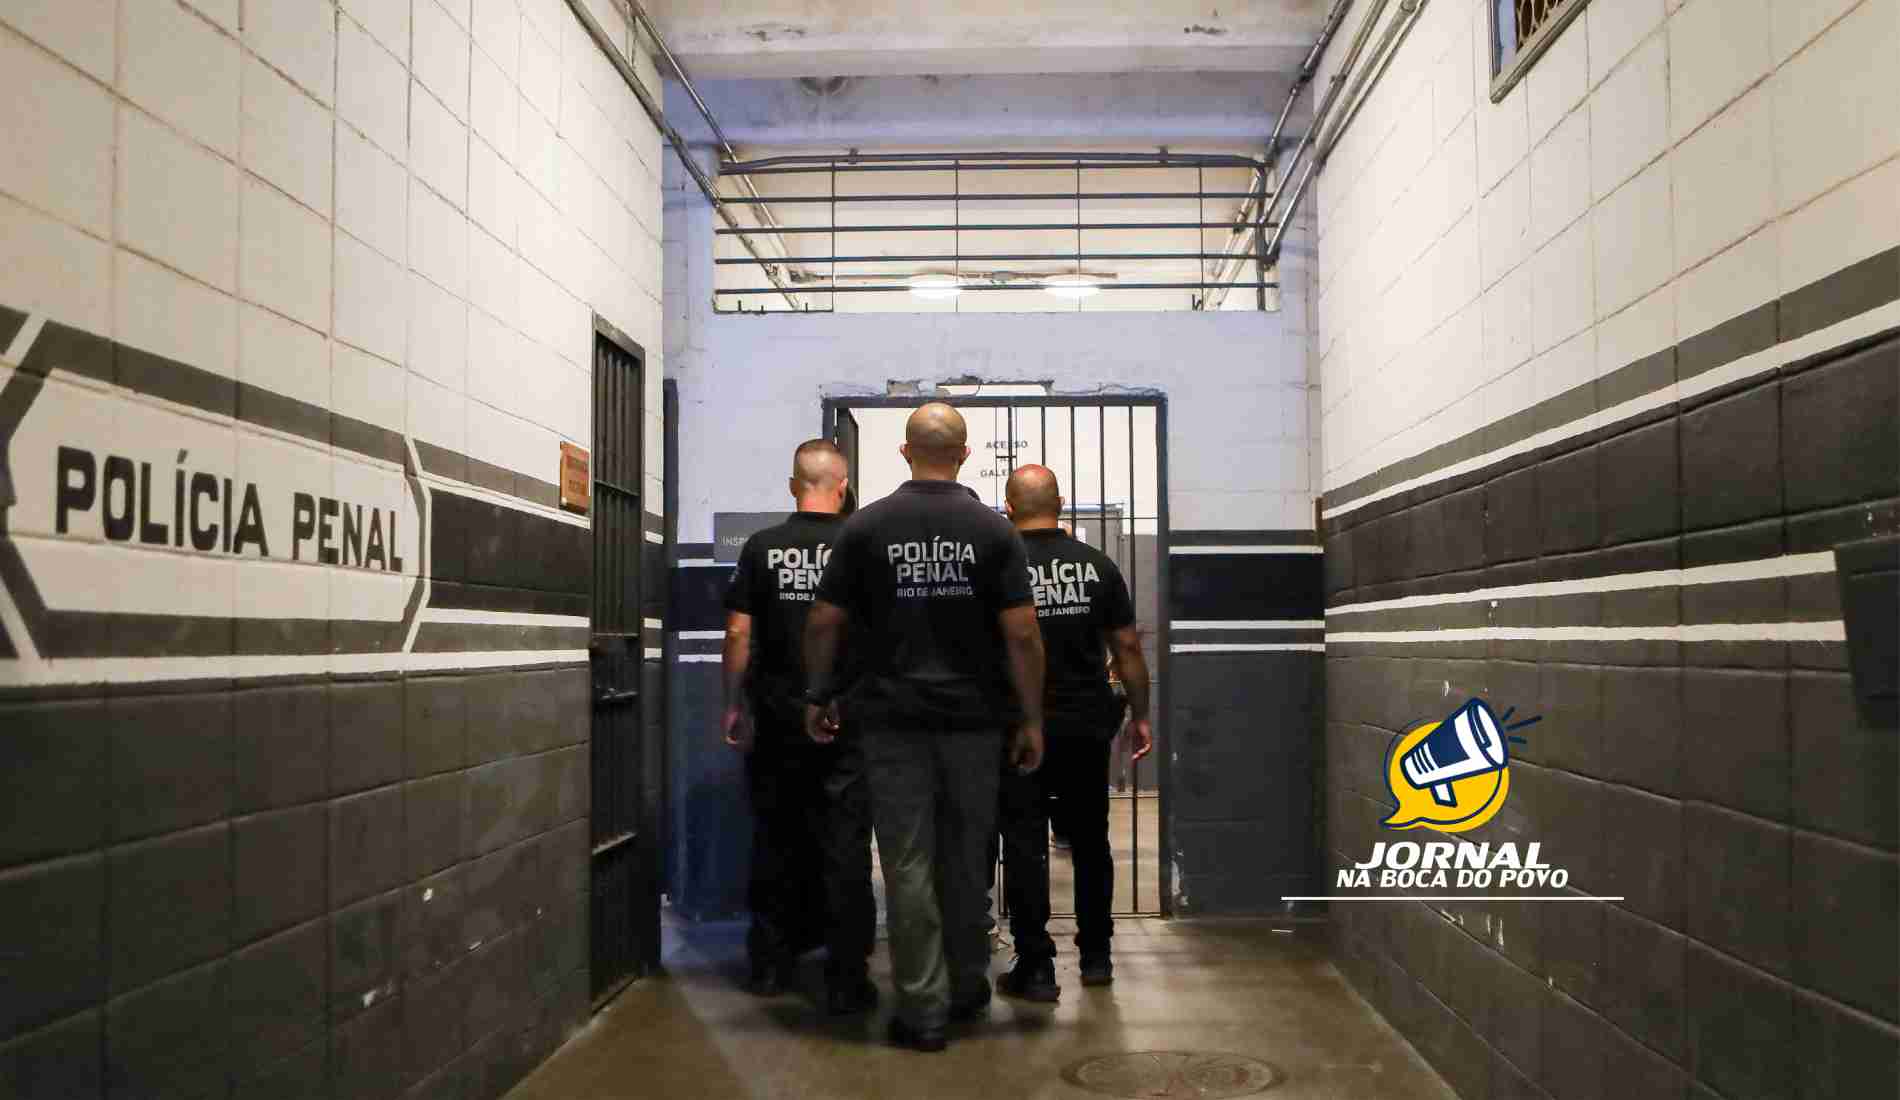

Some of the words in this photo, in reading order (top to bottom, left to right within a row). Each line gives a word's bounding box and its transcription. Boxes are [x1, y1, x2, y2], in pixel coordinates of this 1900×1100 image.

[985, 440, 1028, 449] ACESO
[980, 469, 1008, 478] GALE
[55, 445, 269, 557] POLÍCIA
[292, 492, 403, 573] PENAL
[888, 535, 976, 565] POLÍCIA
[779, 569, 824, 590] PEN
[896, 562, 969, 583] PENAL
[1026, 558, 1100, 586] OLÍCIA
[1031, 582, 1092, 607] ENAL
